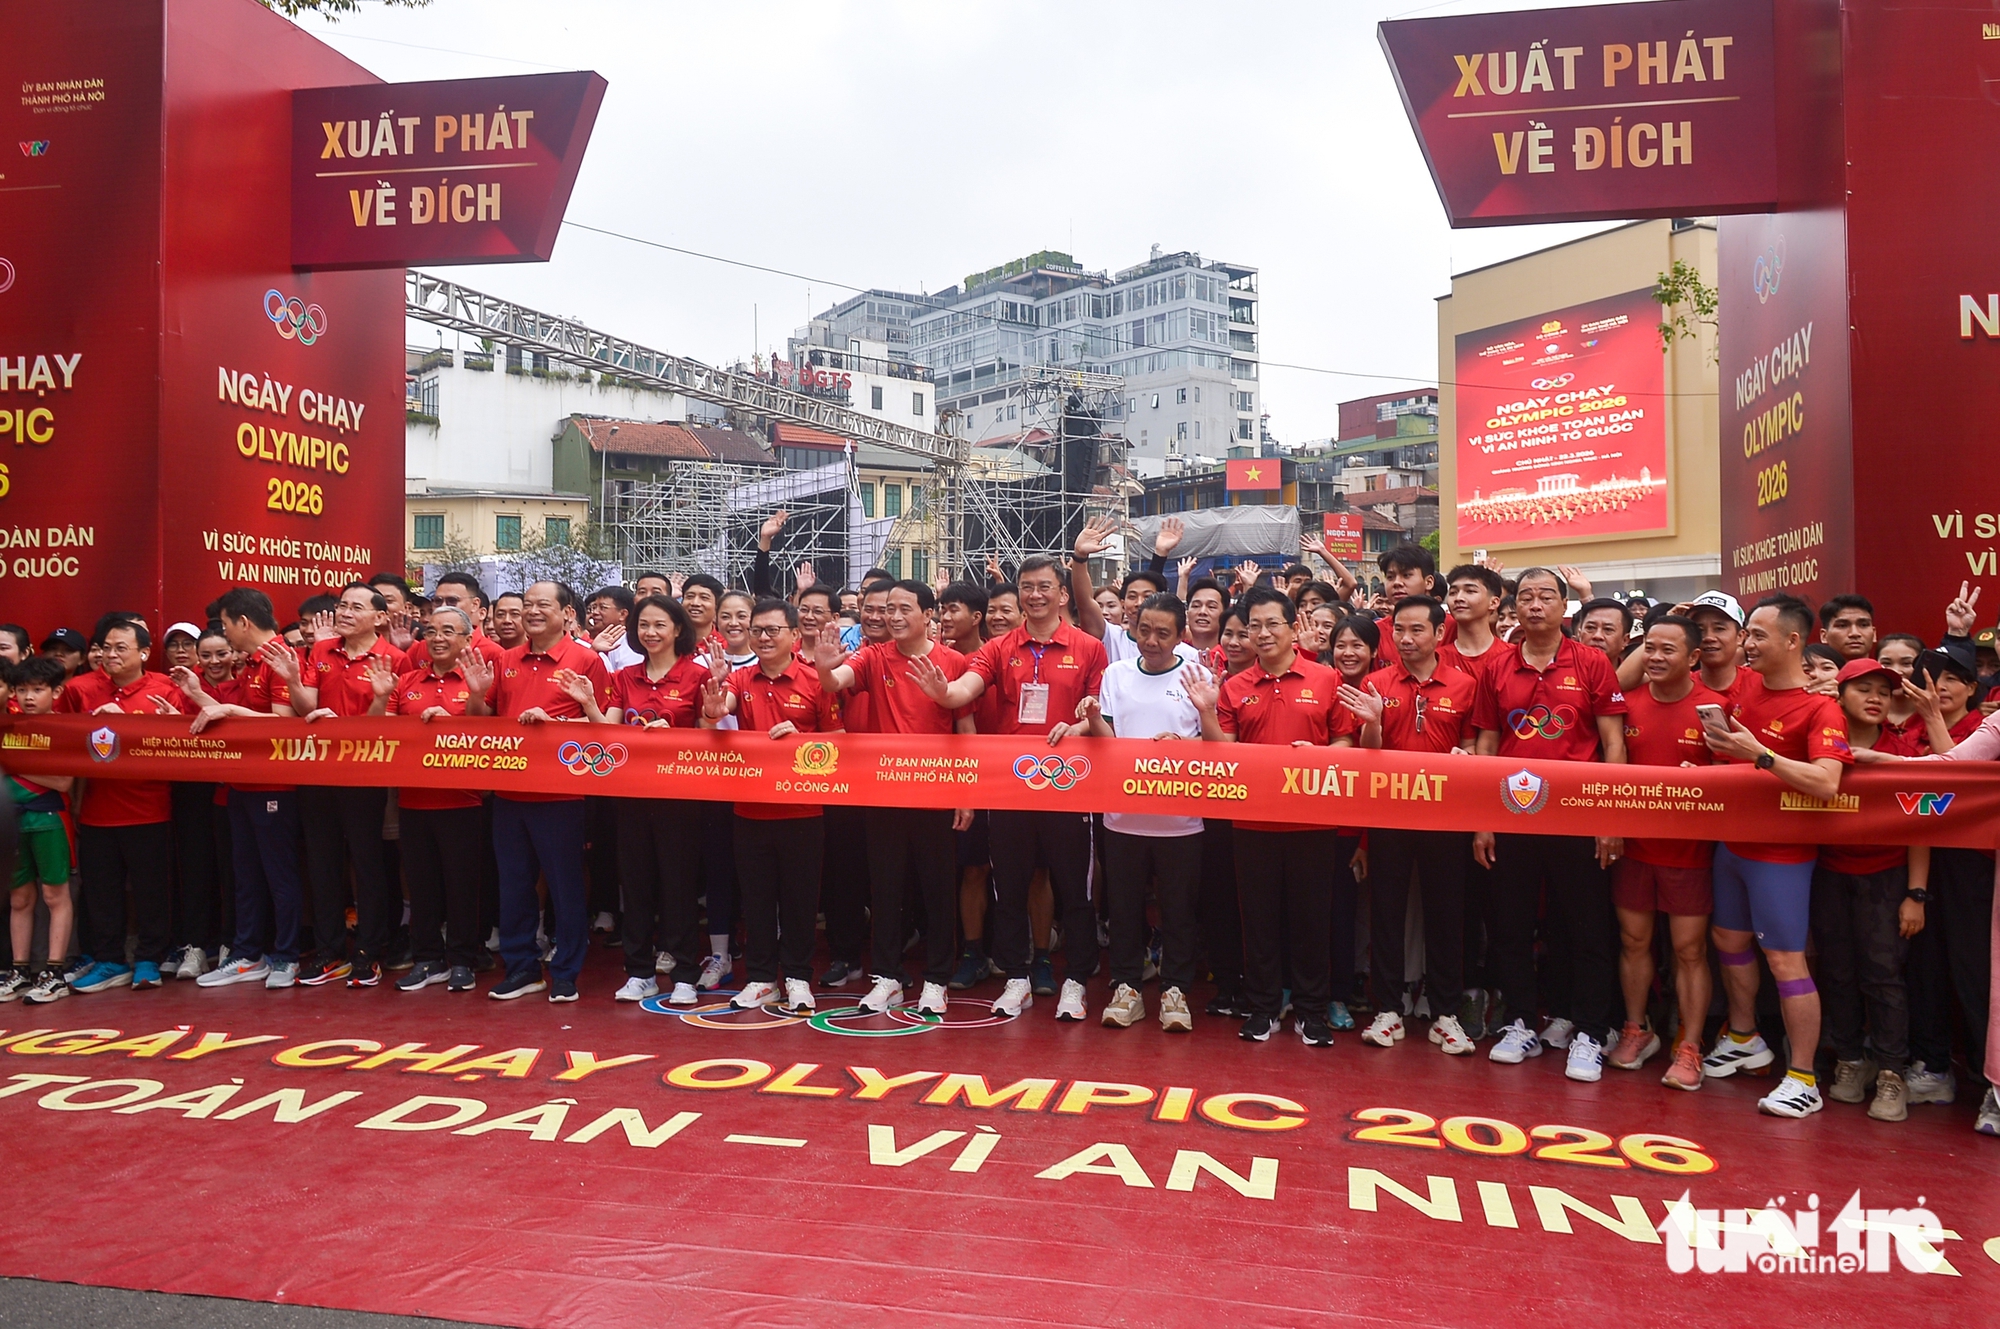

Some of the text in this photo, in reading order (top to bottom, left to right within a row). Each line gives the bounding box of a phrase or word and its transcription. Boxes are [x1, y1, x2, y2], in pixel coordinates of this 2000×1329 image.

[1453, 30, 1733, 97] XUẤT PHÁT
[21, 90, 105, 105] THÀNH PHỐ HÀ NỘI
[22, 78, 103, 93] ỦY BAN NHÂN DÂN
[320, 104, 534, 159] XUẤT PHÁT
[19, 140, 50, 157] VTV
[1492, 117, 1692, 175] VỀ ĐÍCH
[349, 178, 500, 227] VỀ ĐÍCH
[1046, 263, 1065, 272] COFFEE
[1736, 322, 1812, 410] NGÀY CHẠY
[218, 366, 365, 434] NGÀY CHẠY
[1486, 396, 1628, 428] OLYMPIC 2026
[1496, 384, 1615, 416] NGÀY CHẠY
[1468, 409, 1644, 445] VÌ SỨC KHỎE TOÀN DÂN
[1482, 422, 1634, 454] VÌ AN NINH TỔ QUỐC
[1743, 392, 1803, 459] OLYMPIC
[236, 422, 349, 474] OLYMPIC
[267, 477, 323, 515] 2026
[1757, 460, 1787, 507] 2026
[48, 524, 94, 547] DÂN
[1932, 510, 1963, 538] VÌ
[203, 528, 371, 565] VÌ SỨC KHỎE TOÀN DÂN
[1733, 521, 1823, 568] VÌ SỨC KHỎE TOÀN DÂN
[13, 552, 79, 578] QUỐC
[218, 559, 233, 581] VÌ
[237, 563, 259, 582] AN
[263, 565, 299, 584] NINH
[303, 564, 321, 587] TỔ
[1739, 555, 1818, 595] VÌ AN NINH TỔ QUỐC
[1965, 547, 1997, 576] VÌ
[2, 733, 51, 748] Nhân Dân
[130, 748, 153, 757] CÔNG
[168, 749, 189, 758] NHÂN
[190, 750, 207, 758] DÂN
[208, 750, 224, 760] VIỆT
[224, 751, 242, 760] NAM
[142, 736, 226, 749] HIỆP HỘI THỂ THAO
[269, 734, 400, 762] XUẤT PHÁT
[435, 733, 524, 752] NGÀY CHẠY
[422, 753, 528, 770] OLYMPIC 2026
[657, 763, 763, 779] THỂ THAO VÀ DU LỊCH
[678, 750, 746, 764] BỘ VĂN HÓA,
[880, 754, 979, 768] ỦY BAN NHÂN DÂN
[1134, 756, 1239, 779] NGÀY CHẠY
[775, 780, 849, 793] BỘ CÔNG AN
[876, 769, 978, 785] THÀNH PHỐ HÀ NỘI
[1122, 779, 1248, 800] OLYMPIC 2026
[1281, 764, 1448, 801] XUẤT PHÁT
[1582, 782, 1703, 799] HIỆP HỘI THỂ THAO
[1561, 797, 1724, 812] CÔNG AN NHÂN DÂN VIỆT NAM
[1895, 792, 1956, 816] VTV
[272, 1040, 657, 1082] CHẠY
[662, 1057, 1309, 1132] OLYMPIC
[1350, 1107, 1720, 1175] 2026
[0, 1073, 362, 1123] TOÀN
[354, 1096, 702, 1149] DÂN
[867, 1124, 1002, 1173] VÌ
[1034, 1142, 1280, 1201] AN
